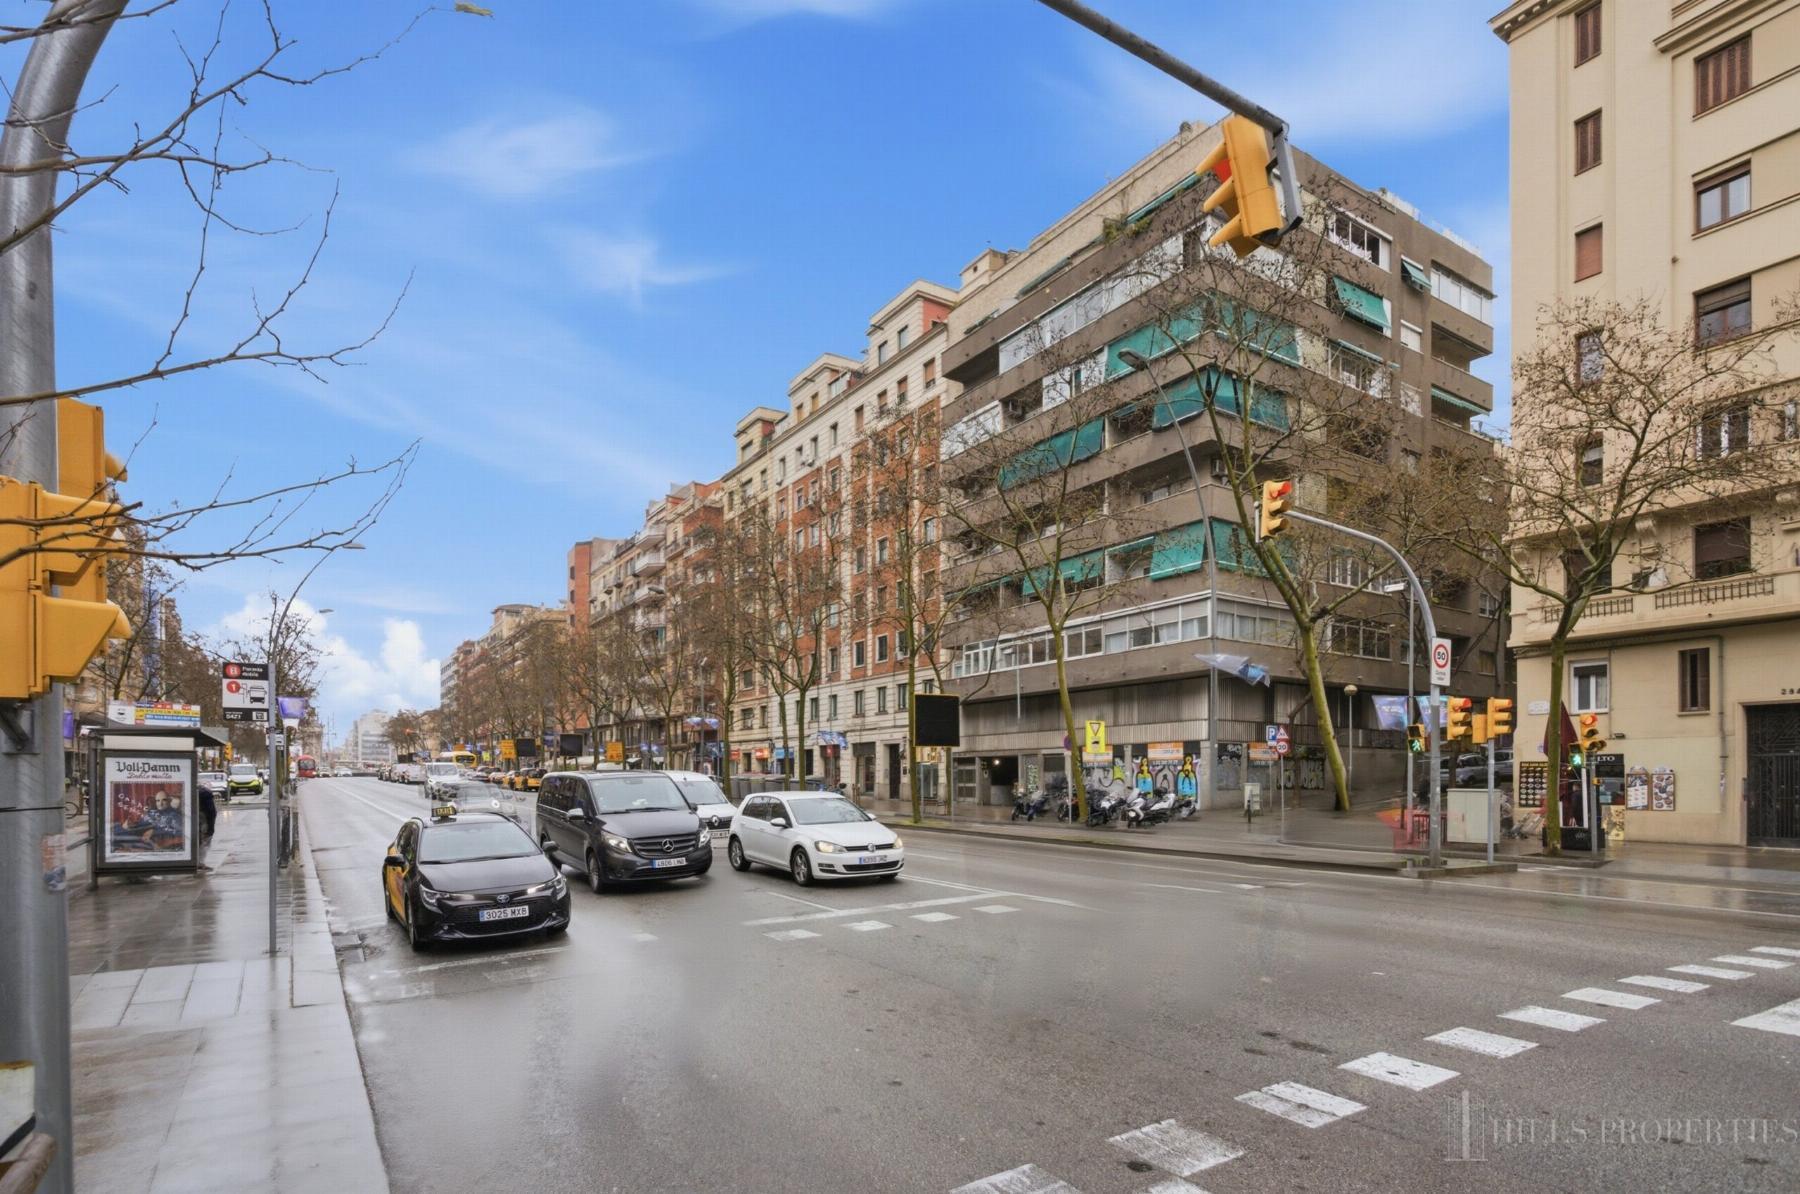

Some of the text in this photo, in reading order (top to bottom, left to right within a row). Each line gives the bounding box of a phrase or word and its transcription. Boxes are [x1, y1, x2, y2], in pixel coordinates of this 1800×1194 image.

[1437, 651, 1446, 661] 50
[1269, 727, 1276, 740] P
[116, 761, 181, 773] Voll-Damm
[485, 909, 509, 920] 3025
